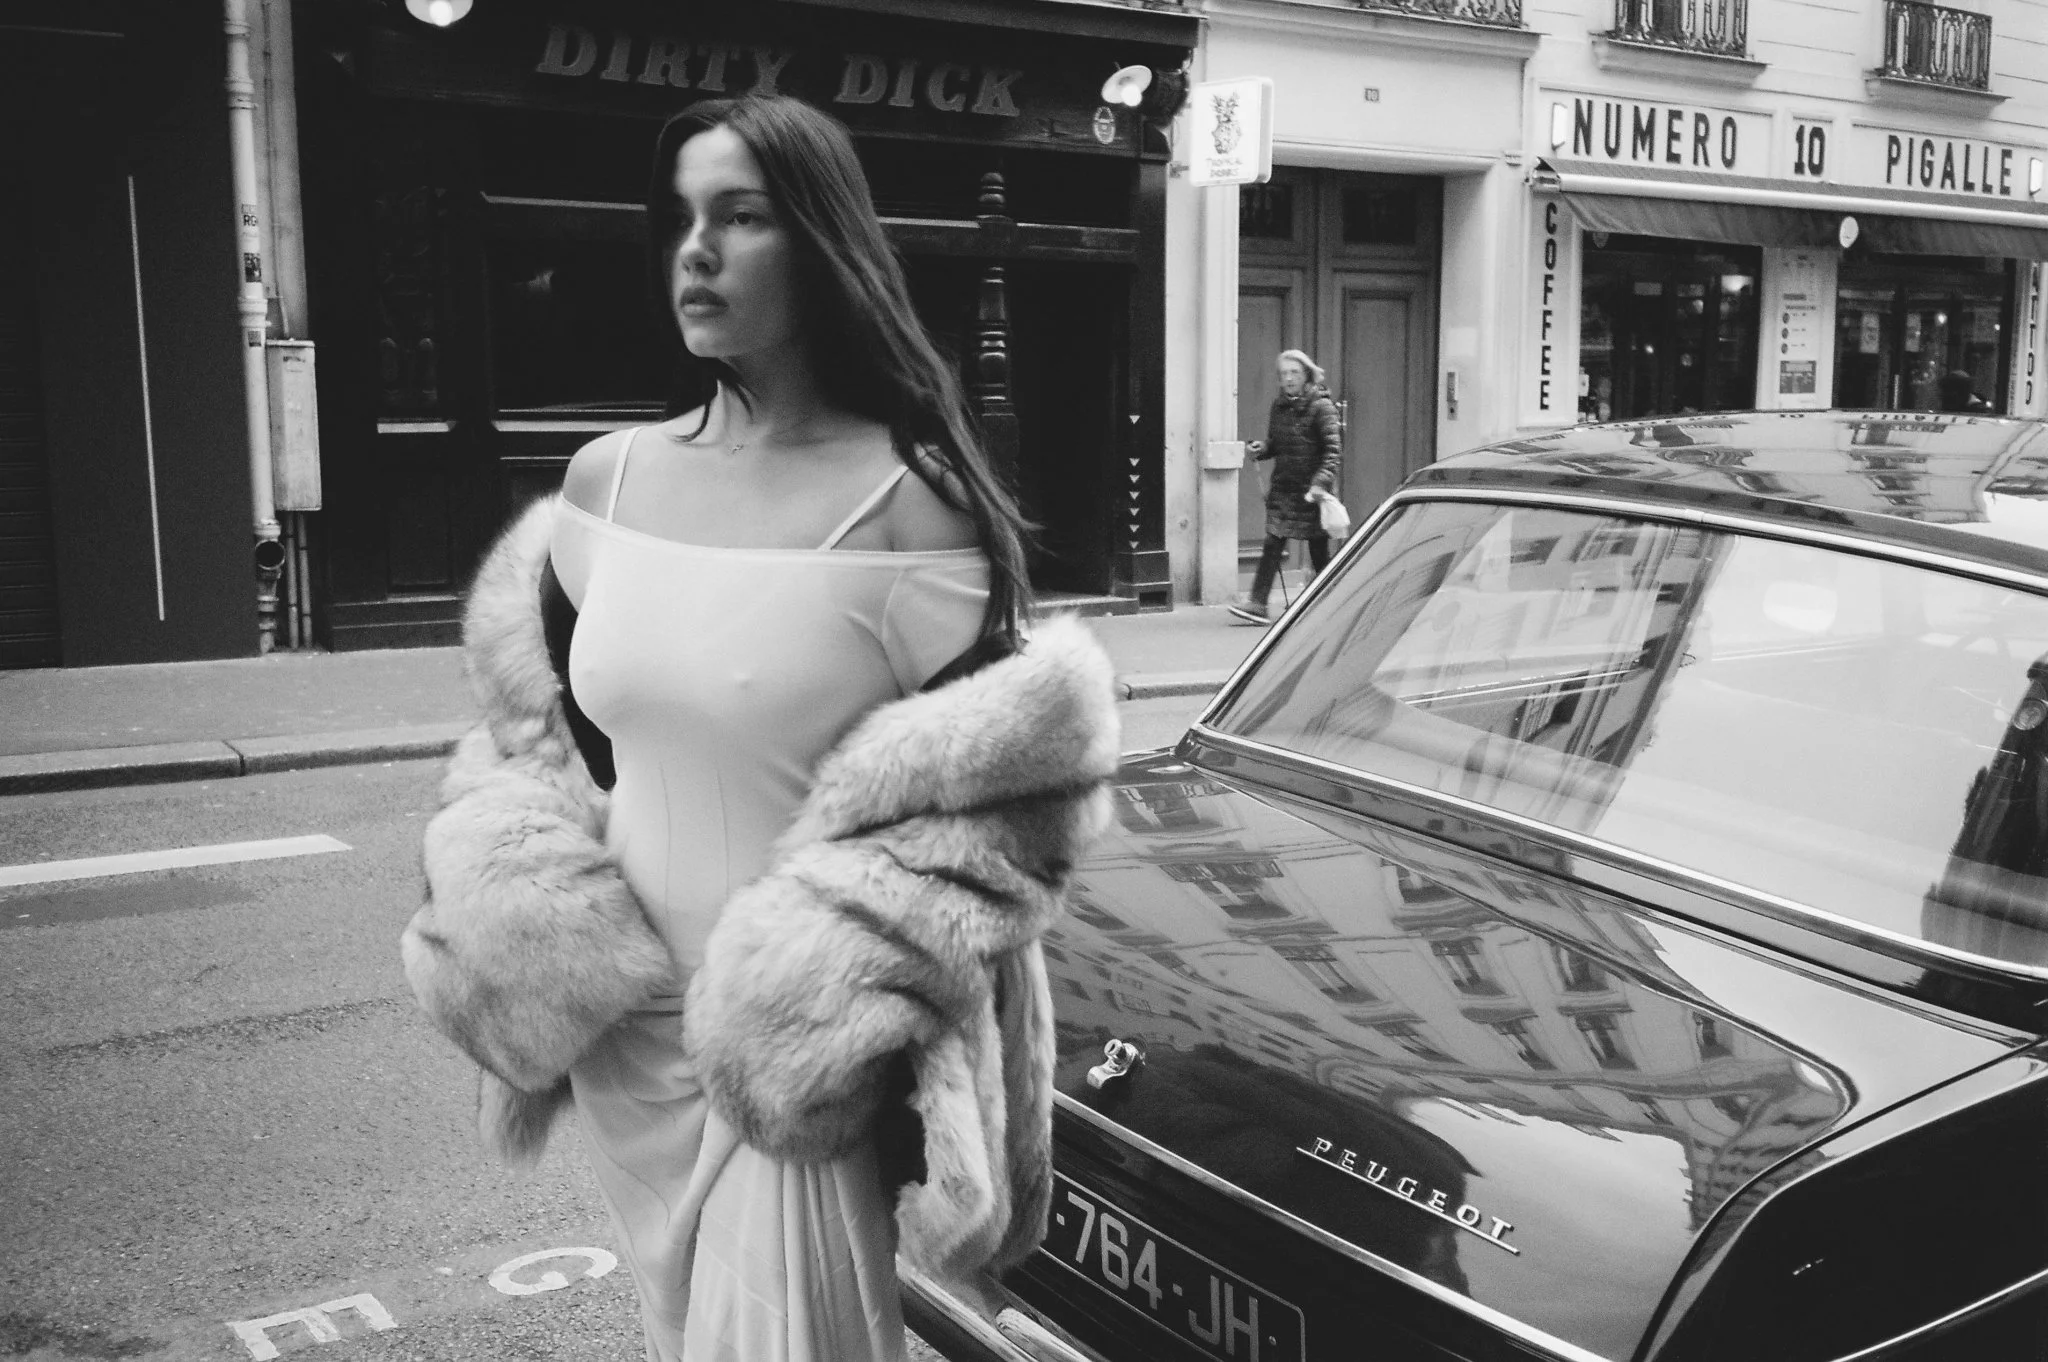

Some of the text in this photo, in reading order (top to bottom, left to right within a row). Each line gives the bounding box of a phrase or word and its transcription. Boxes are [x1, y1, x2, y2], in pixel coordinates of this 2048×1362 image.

[536, 24, 1023, 117] DIRTY DICK
[1574, 98, 2014, 195] NUMERO 10 PIGALLE
[1540, 202, 1557, 411] COFFEE
[1314, 1137, 1514, 1240] PEUGEOT
